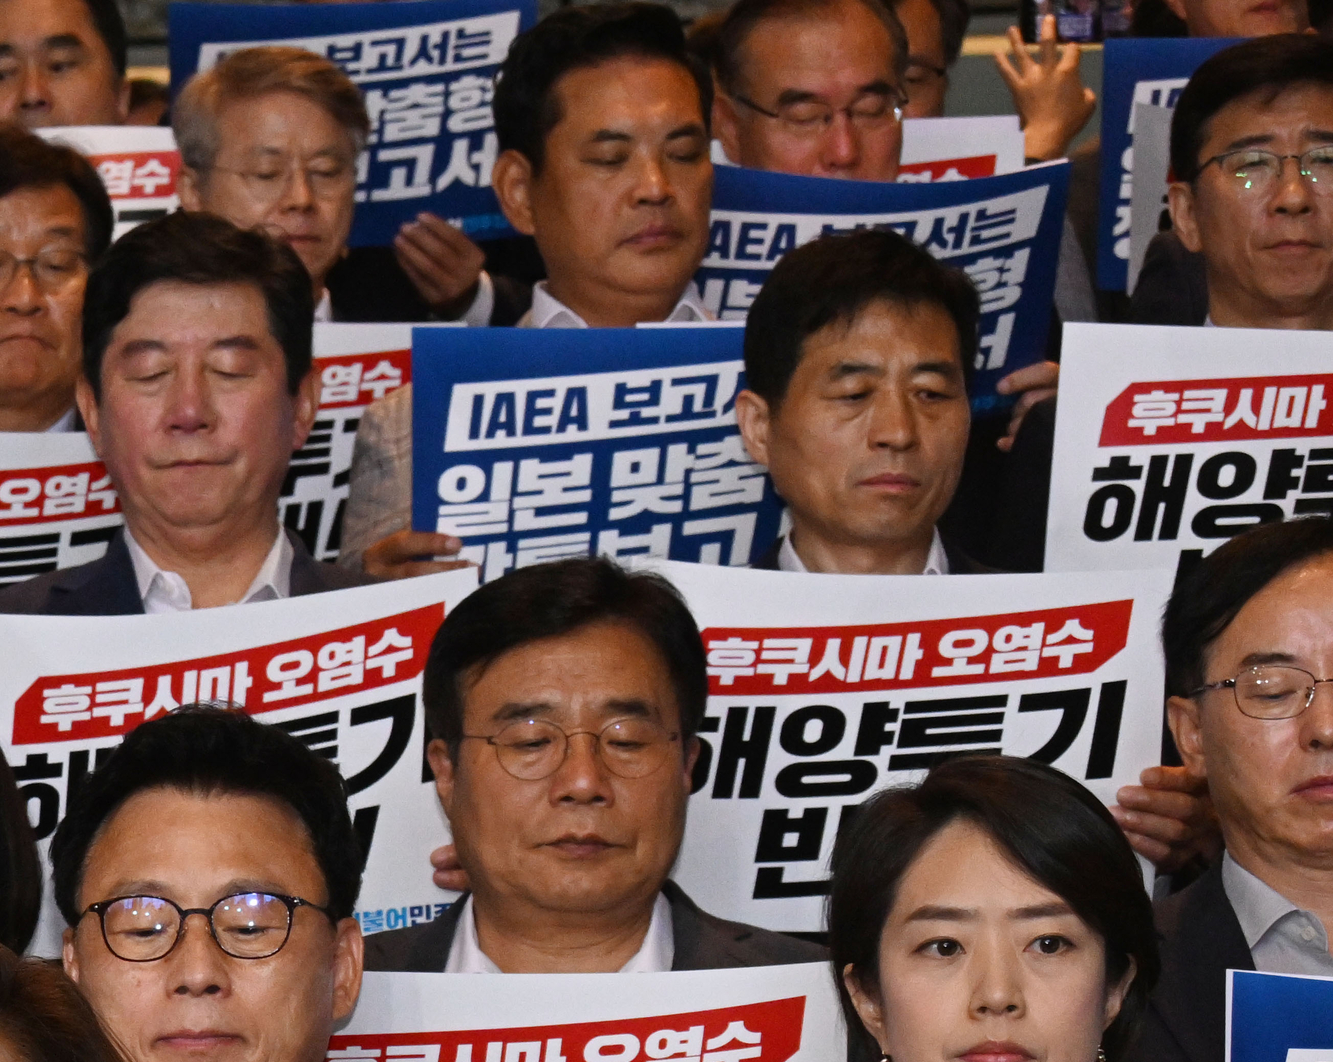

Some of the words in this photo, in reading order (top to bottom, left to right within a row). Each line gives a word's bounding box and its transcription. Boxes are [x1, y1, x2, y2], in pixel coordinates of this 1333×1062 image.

[326, 27, 493, 75] 보고서는
[97, 159, 171, 195] 염수
[320, 360, 402, 404] 염수
[468, 386, 589, 441] IAEA
[1127, 384, 1328, 437] 후쿠시마
[435, 452, 592, 536] 일본
[608, 434, 768, 521] 맞춤
[707, 632, 924, 686] 후쿠시마
[931, 618, 1095, 678] 오염수
[40, 661, 254, 732] 후쿠시마
[262, 628, 415, 705] 오염수
